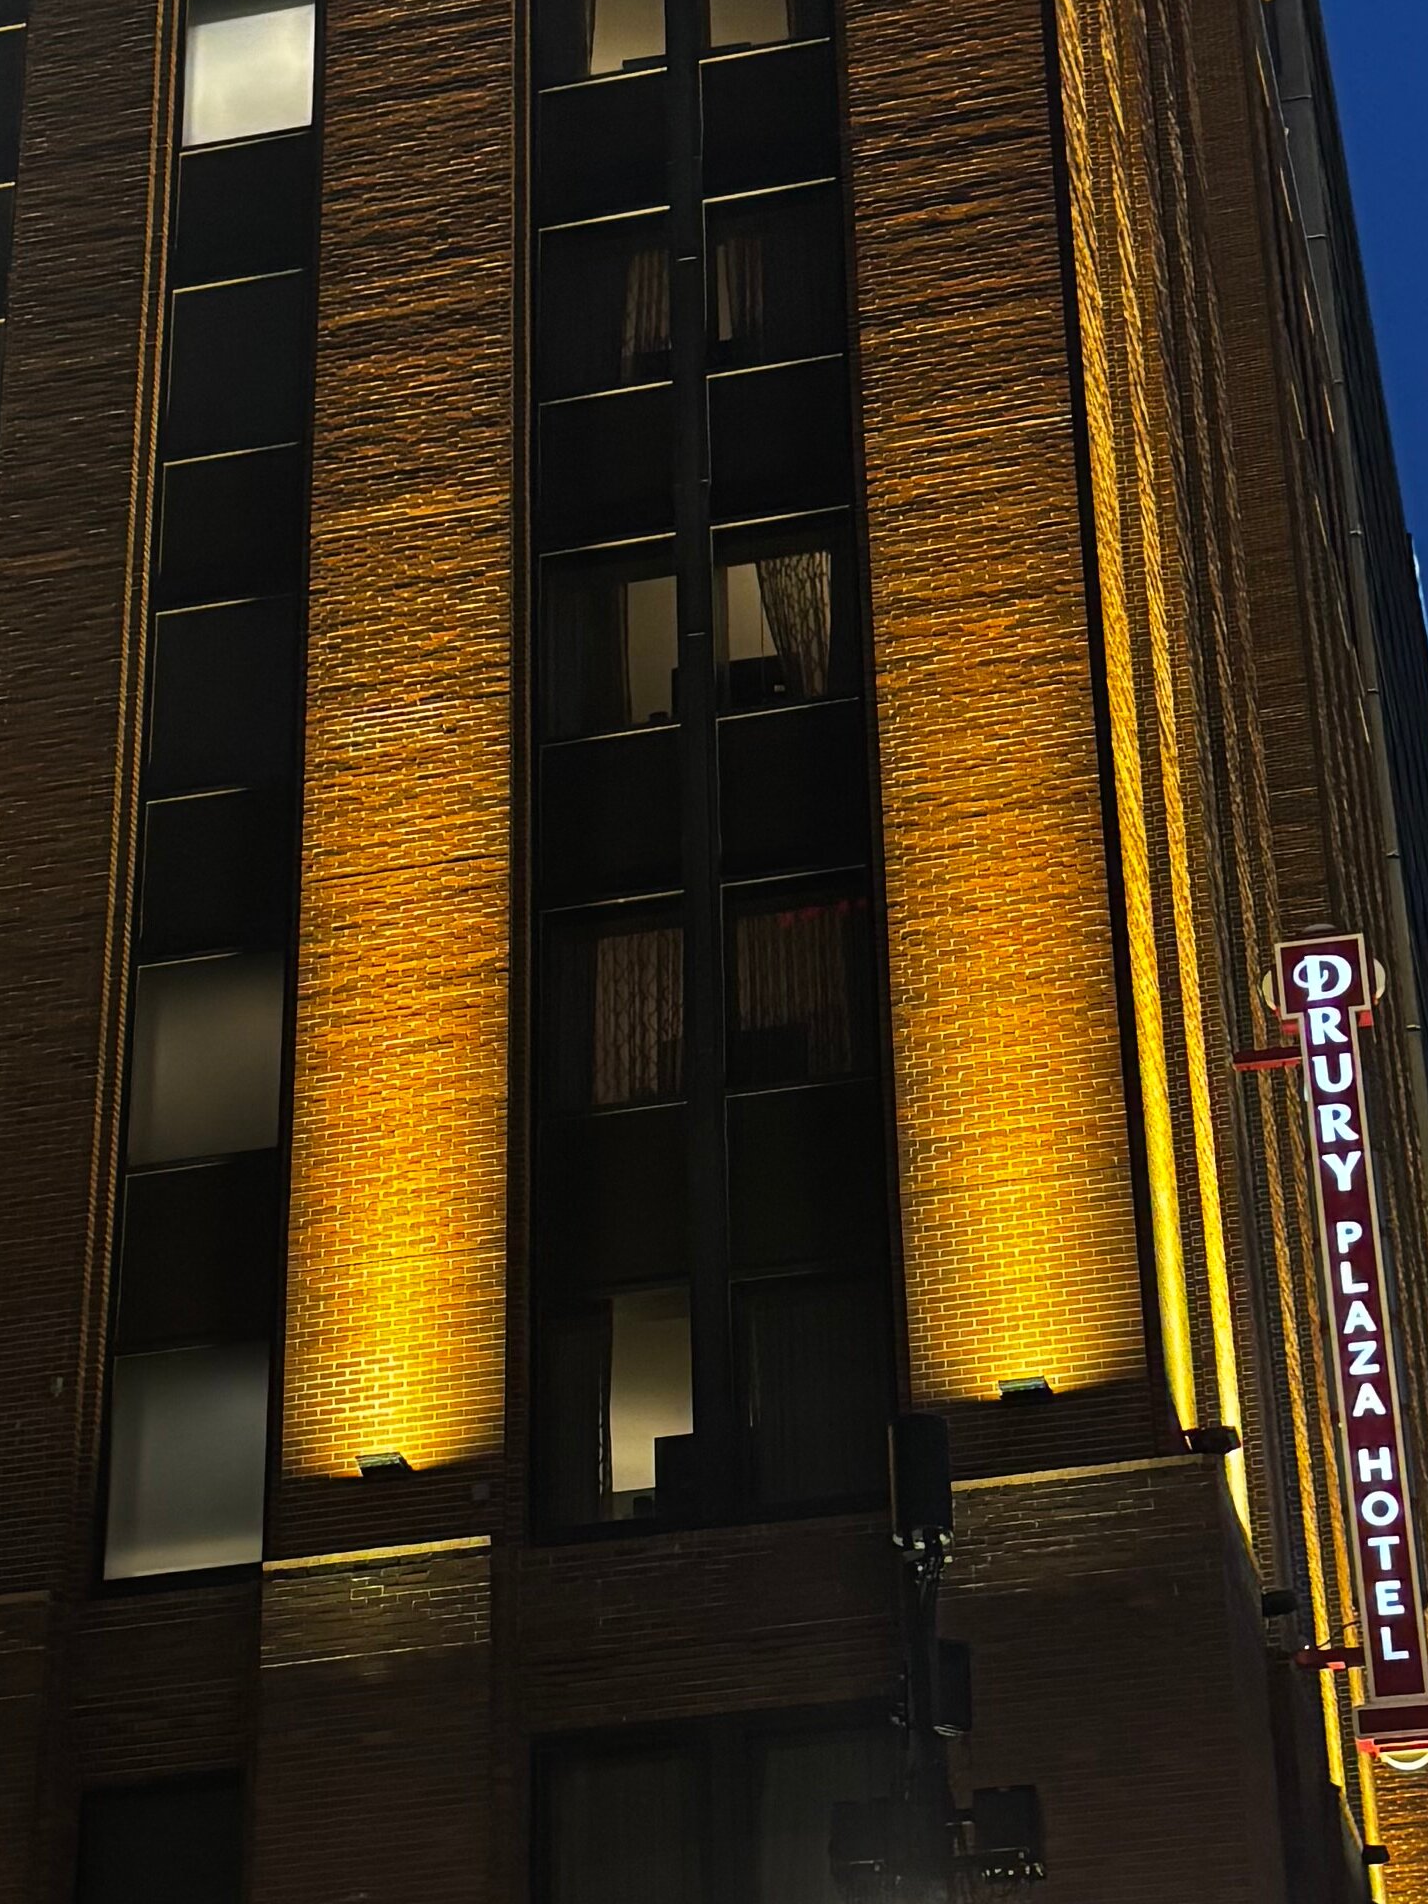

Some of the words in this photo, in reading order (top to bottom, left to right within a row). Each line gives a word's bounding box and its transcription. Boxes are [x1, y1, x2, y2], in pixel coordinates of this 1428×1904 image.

[1292, 953, 1363, 1192] DRURY
[1335, 1221, 1387, 1418] PLAZA
[1357, 1446, 1411, 1661] HOTEL
